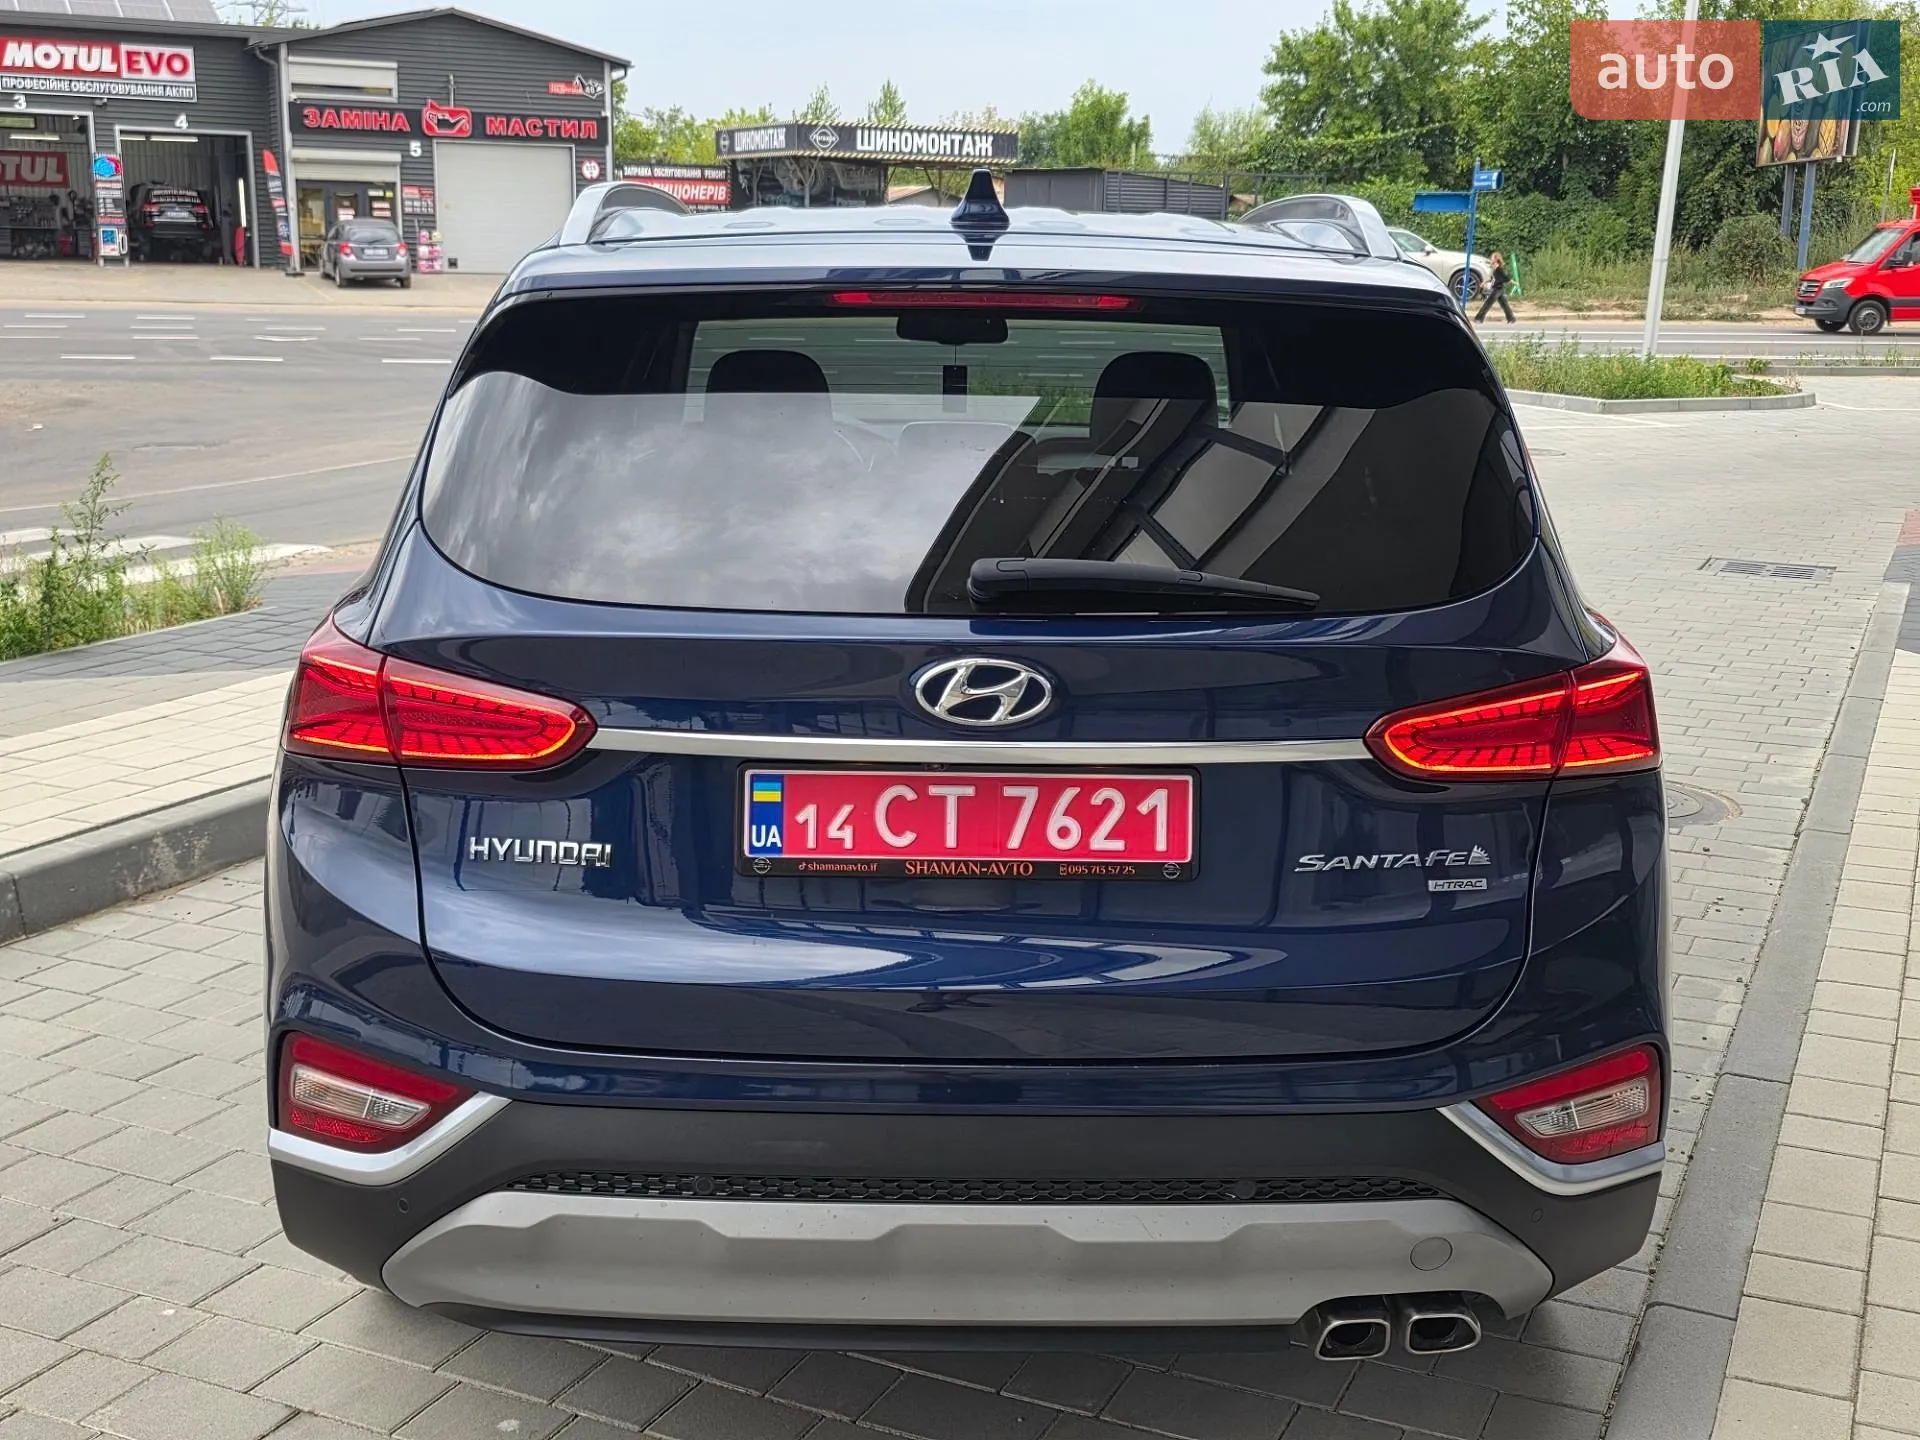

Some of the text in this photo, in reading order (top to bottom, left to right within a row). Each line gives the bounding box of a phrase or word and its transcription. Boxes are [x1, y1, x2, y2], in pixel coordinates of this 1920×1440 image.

[2, 40, 190, 76] MOTUL EVO
[2, 77, 193, 98] ПРОФЕСІЙНЕ ОБСЛУГОВУВАННЯ АКПП
[14, 95, 27, 110] 3
[174, 113, 188, 130] 4
[303, 106, 598, 140] ЗАМІНА МАСТИЛ
[410, 141, 422, 157] 5
[734, 127, 786, 152] ШИНОМОНТАЖ
[856, 129, 994, 157] ШИНОМОНТАЖ
[795, 784, 1168, 852] 14 CT 7621
[751, 825, 782, 848] UA
[469, 836, 612, 867] HYUNDAI
[807, 861, 878, 873] shamanavto.if
[904, 861, 1033, 876] SHAMAN-AVTO
[1068, 865, 1088, 875] 095
[1433, 880, 1484, 889] HTRAC
